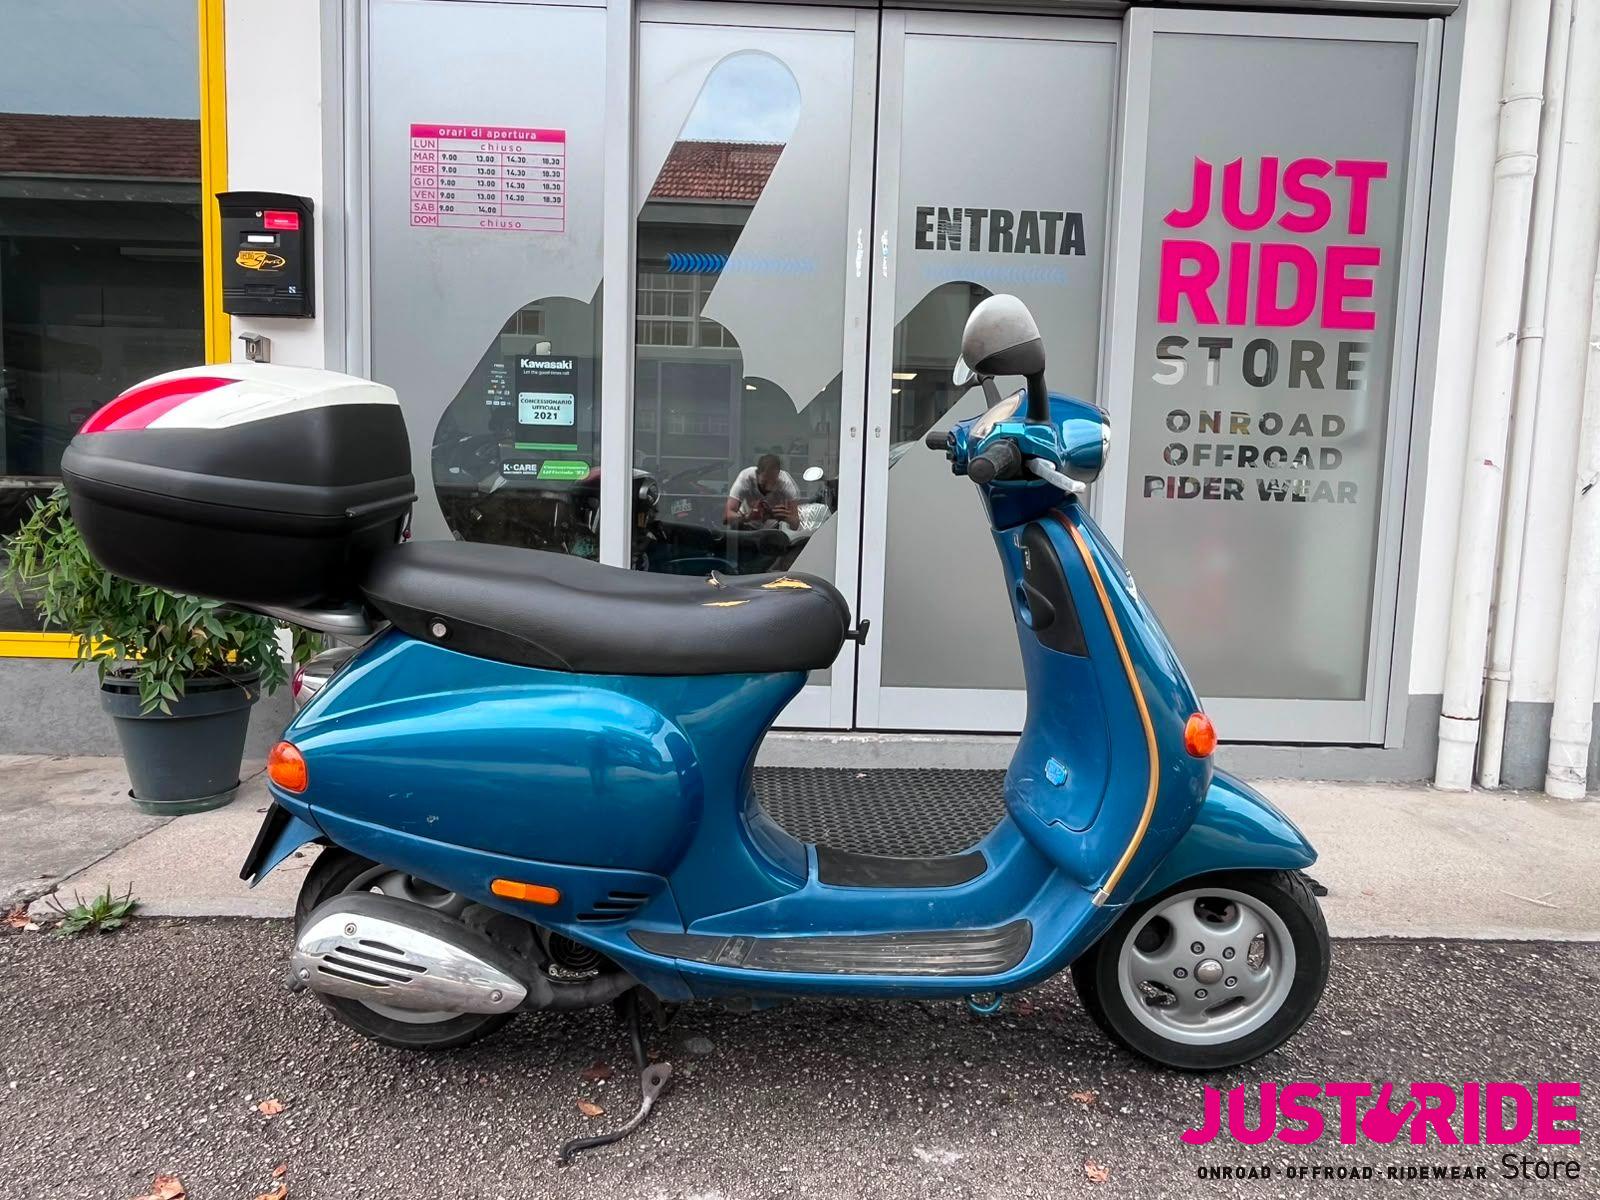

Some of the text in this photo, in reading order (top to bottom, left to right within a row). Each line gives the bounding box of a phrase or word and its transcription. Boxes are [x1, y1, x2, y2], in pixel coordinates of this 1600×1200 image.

[438, 127, 537, 140] orari di apertura
[413, 140, 522, 152] LUN chiuso
[413, 152, 435, 161] MAR
[507, 156, 526, 164] 14.30
[413, 165, 435, 173] MER
[413, 178, 435, 186] GIO
[414, 191, 435, 199] VEN
[505, 194, 525, 202] 14.30
[1162, 154, 1388, 235] JUST
[414, 203, 435, 212] SAB
[413, 215, 522, 229] DOM chiuso
[914, 205, 1087, 257] ENTRATA
[1156, 238, 1381, 331] RIDE
[520, 358, 573, 370] Kawasaki
[1151, 335, 1370, 391] STORE
[534, 412, 558, 420] 2021
[1165, 408, 1347, 438] ONROAD
[1163, 442, 1344, 471] OFFROAD
[1143, 475, 1359, 504] RIDER WEAR
